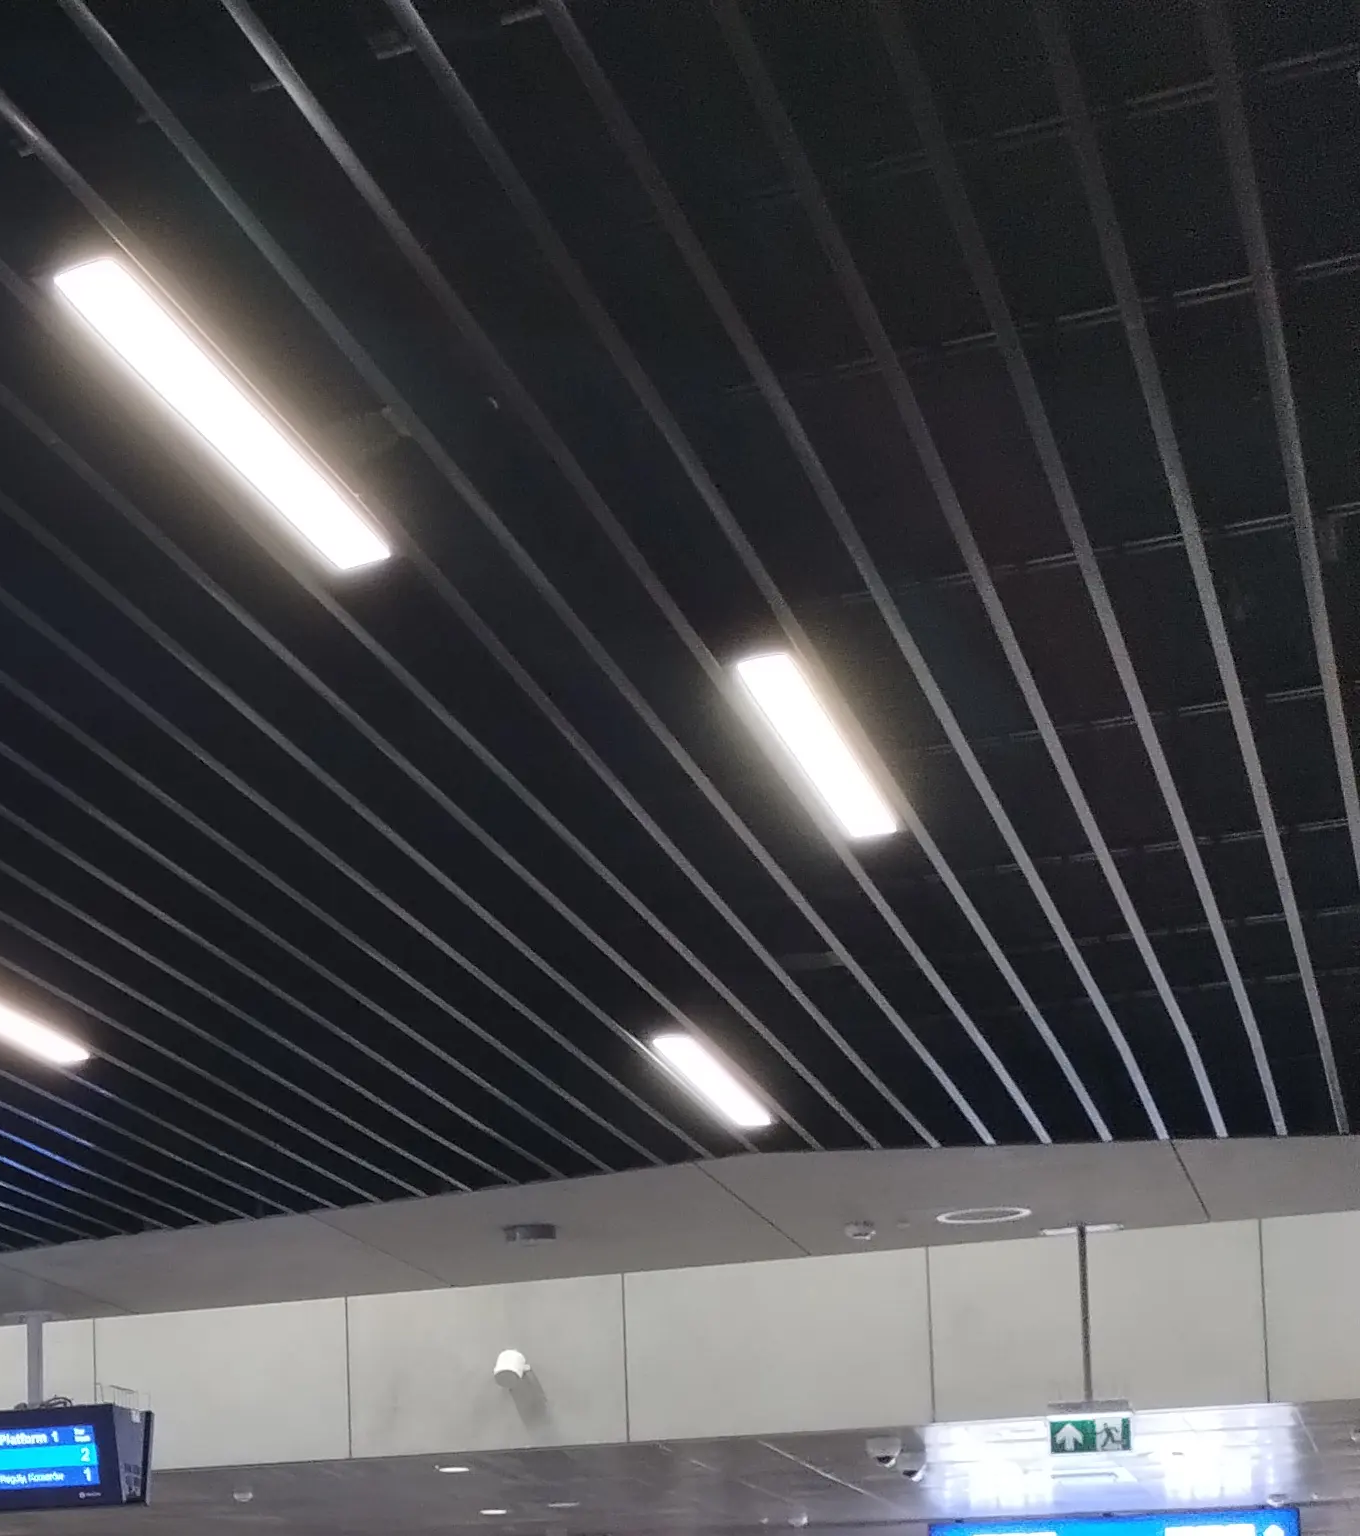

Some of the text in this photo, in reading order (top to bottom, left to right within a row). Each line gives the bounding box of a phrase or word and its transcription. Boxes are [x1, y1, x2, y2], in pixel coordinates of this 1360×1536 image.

[0, 1432, 48, 1446] Platform
[51, 1430, 59, 1443] 1
[81, 1447, 91, 1462] 2
[83, 1466, 92, 1482] 1
